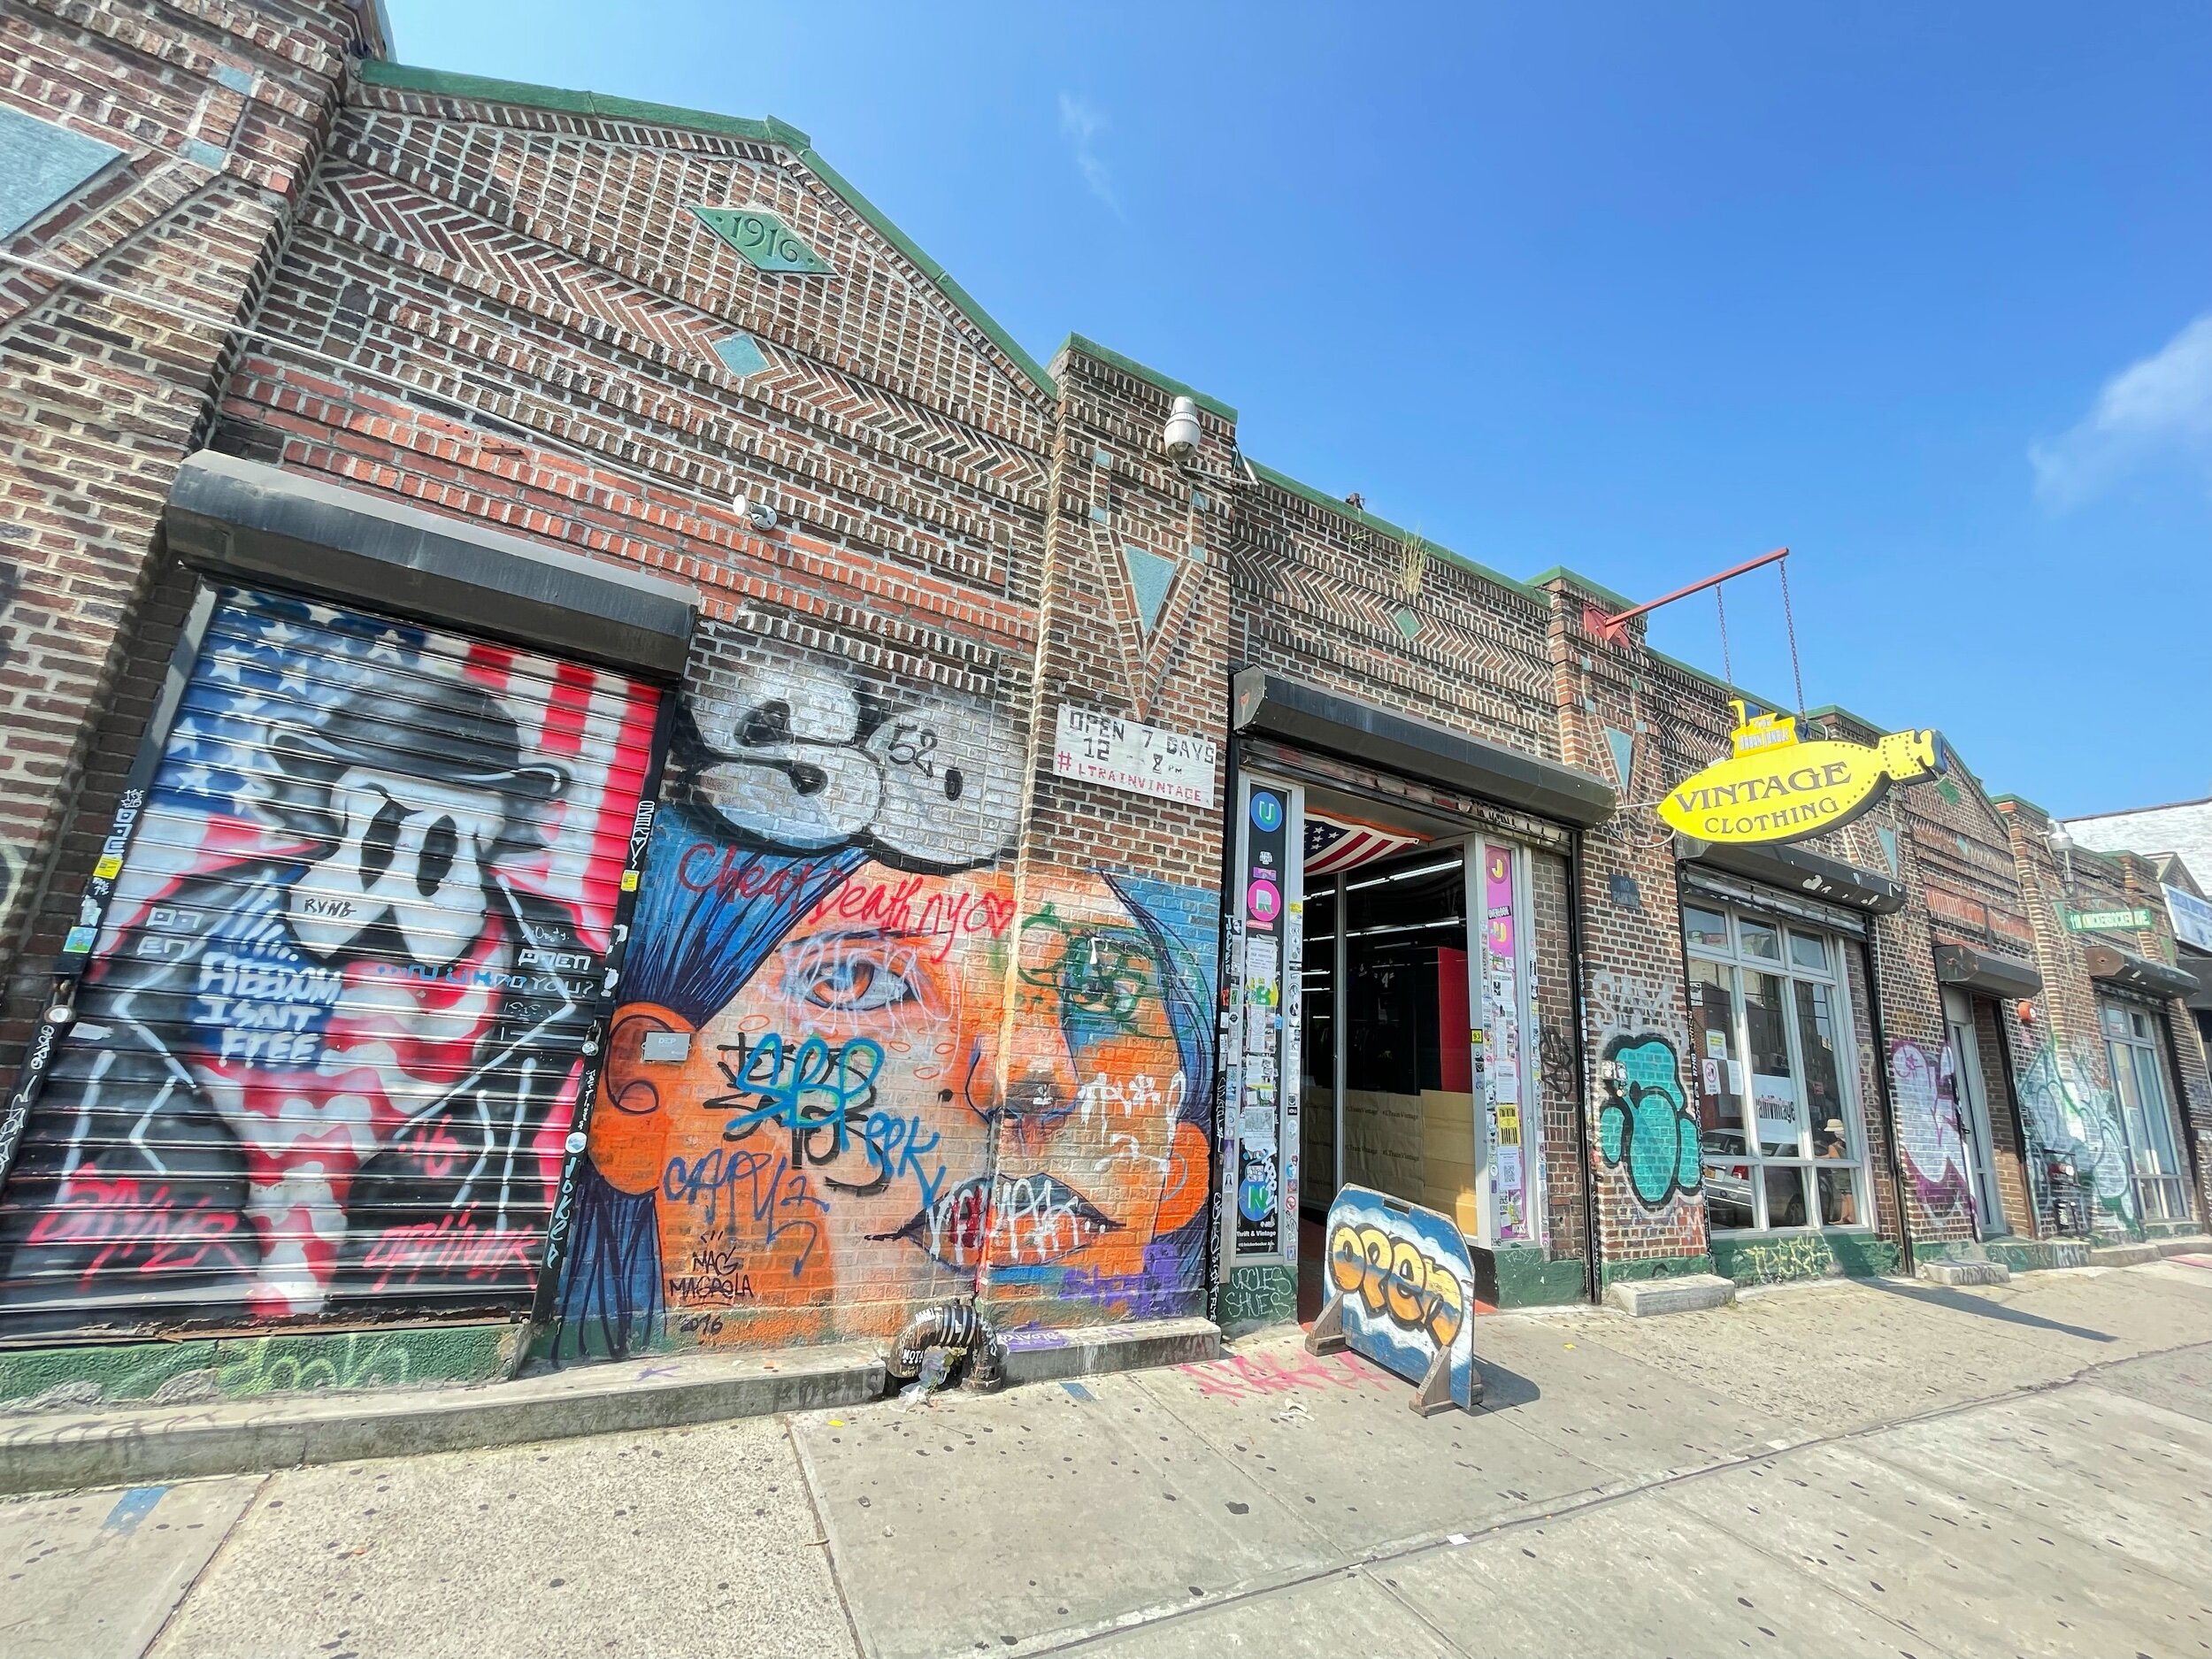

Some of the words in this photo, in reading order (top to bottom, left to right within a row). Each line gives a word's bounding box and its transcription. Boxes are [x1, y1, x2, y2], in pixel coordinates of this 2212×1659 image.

[731, 216, 799, 263] 1916
[1069, 710, 1125, 742] OPEN
[1141, 728, 1153, 749] 7
[1083, 736, 1110, 762] 12
[1674, 761, 1852, 813] VINTAGE
[1704, 796, 1840, 834] CLOTHING
